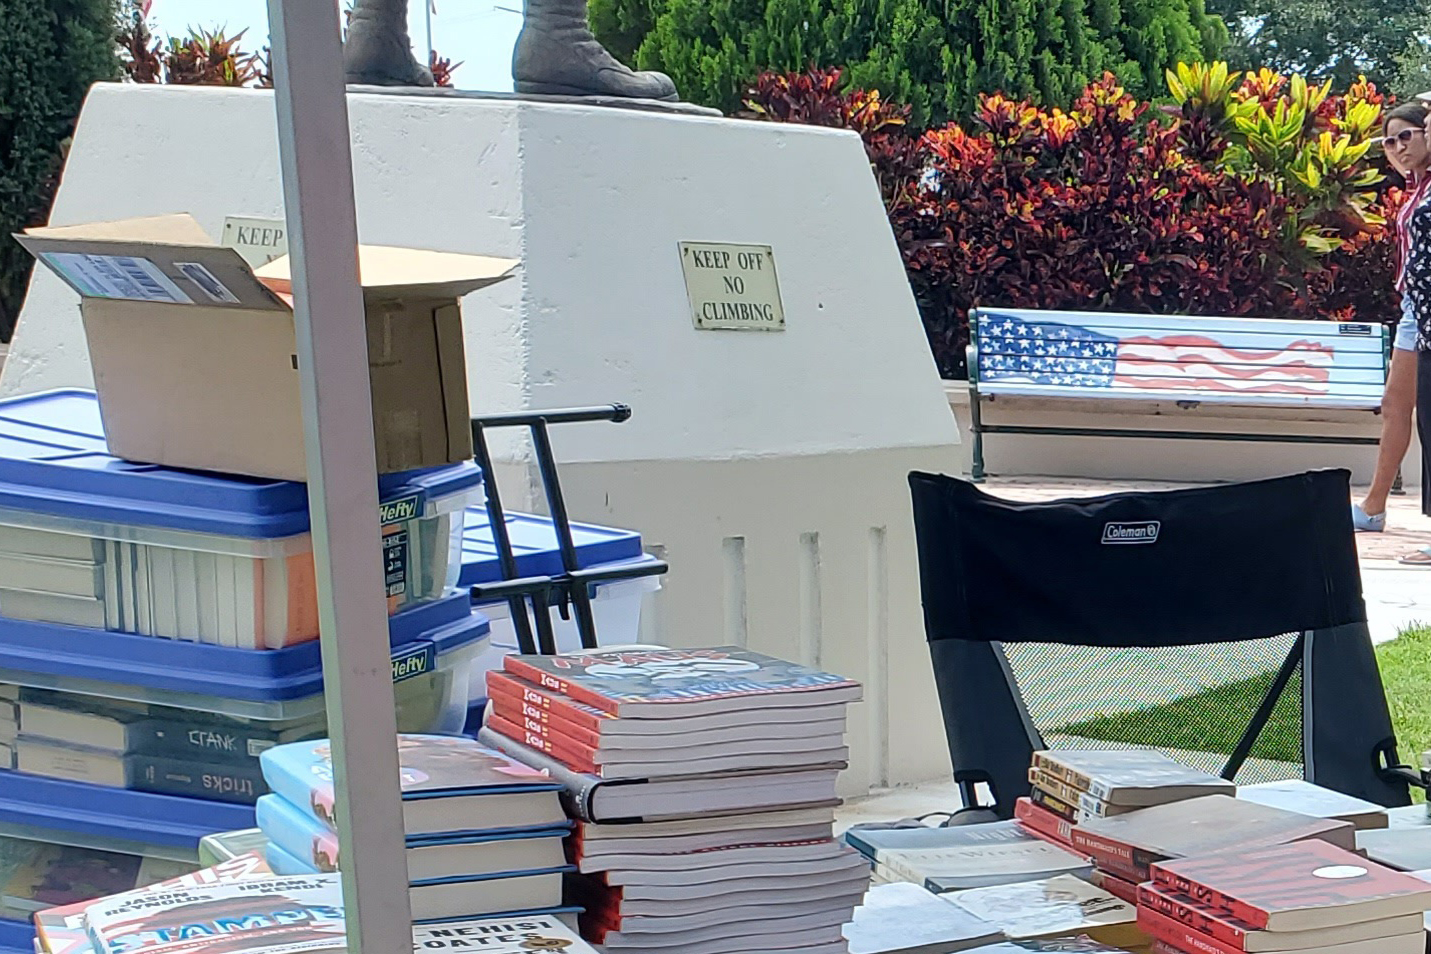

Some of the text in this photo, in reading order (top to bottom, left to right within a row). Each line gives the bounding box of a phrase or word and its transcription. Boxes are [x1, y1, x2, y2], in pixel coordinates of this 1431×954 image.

[237, 226, 283, 247] KEEP
[693, 250, 763, 270] KEEP OFF
[723, 276, 744, 294] NO
[703, 302, 774, 321] CLIMBING
[380, 501, 415, 522] Hefty
[1107, 524, 1146, 538] Coleman
[391, 655, 425, 678] Hefty
[202, 774, 254, 797] tricks
[238, 879, 307, 892] IBRAM
[104, 895, 214, 917] REYNOLDS
[120, 892, 190, 908] JASON
